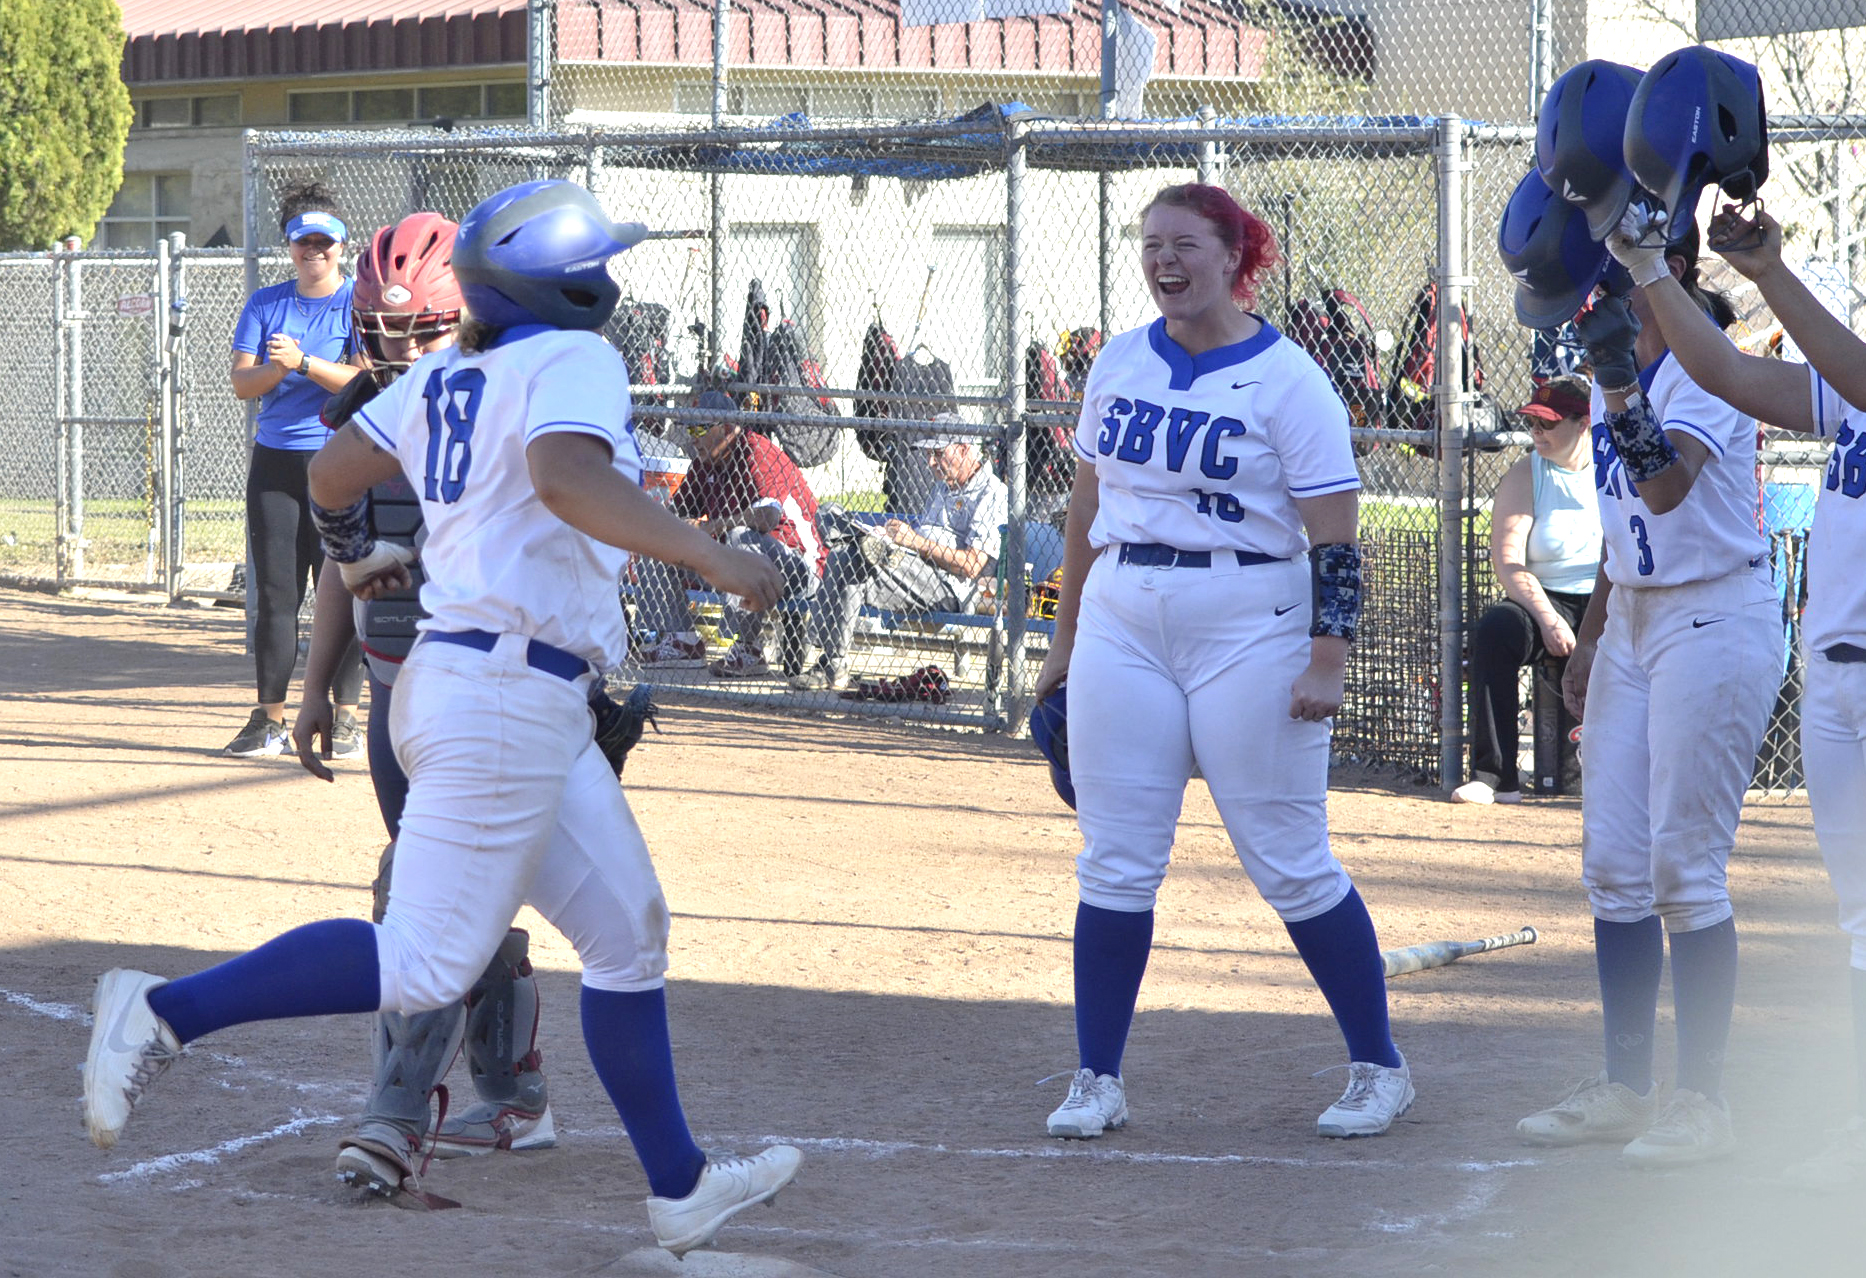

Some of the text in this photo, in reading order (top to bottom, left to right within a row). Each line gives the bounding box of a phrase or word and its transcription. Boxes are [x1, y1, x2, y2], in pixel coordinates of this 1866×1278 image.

[1691, 106, 1701, 144] EASTON
[565, 260, 600, 273] EASTON
[422, 366, 487, 504] 18
[1098, 398, 1246, 480] SBVC
[1630, 515, 1655, 576] 3
